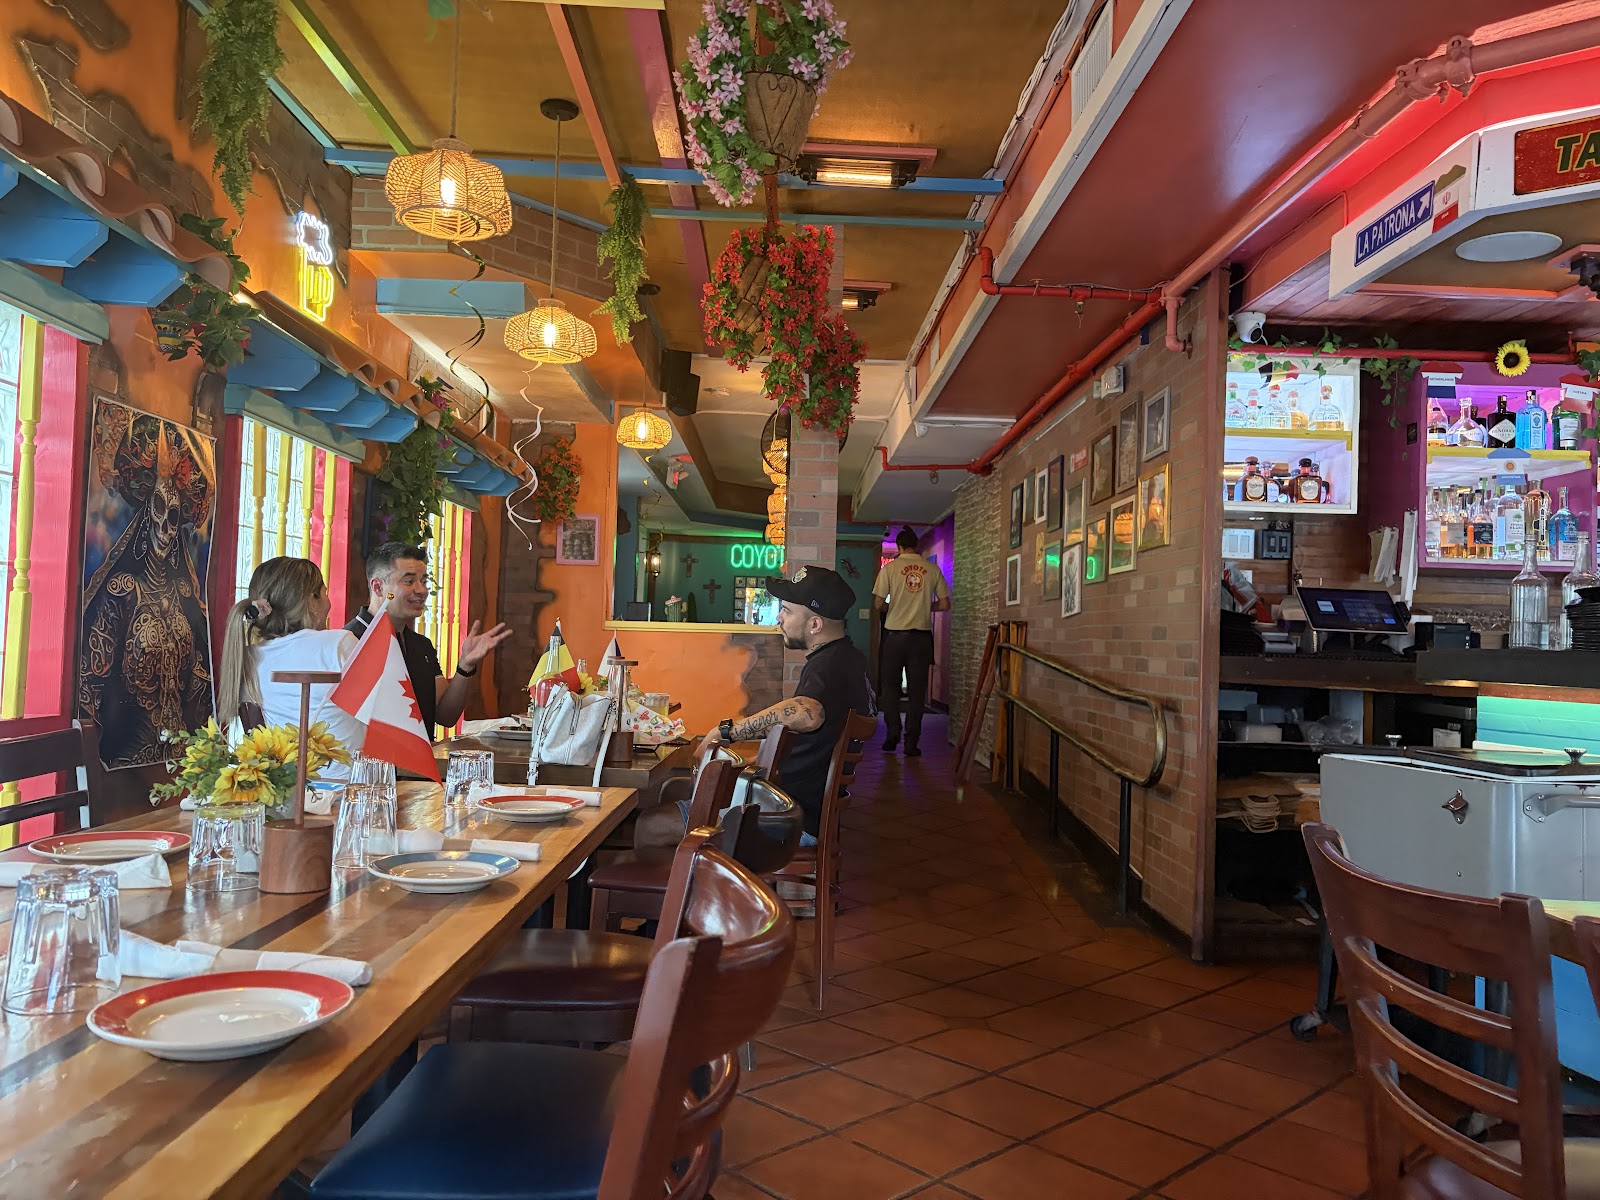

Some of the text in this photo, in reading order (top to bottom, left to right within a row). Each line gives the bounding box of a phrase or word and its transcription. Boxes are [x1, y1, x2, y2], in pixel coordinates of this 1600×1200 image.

[1555, 130, 1600, 173] TA
[1357, 200, 1416, 259] LA PATRONA
[901, 565, 928, 576] COYOTE
[784, 706, 797, 717] ES
